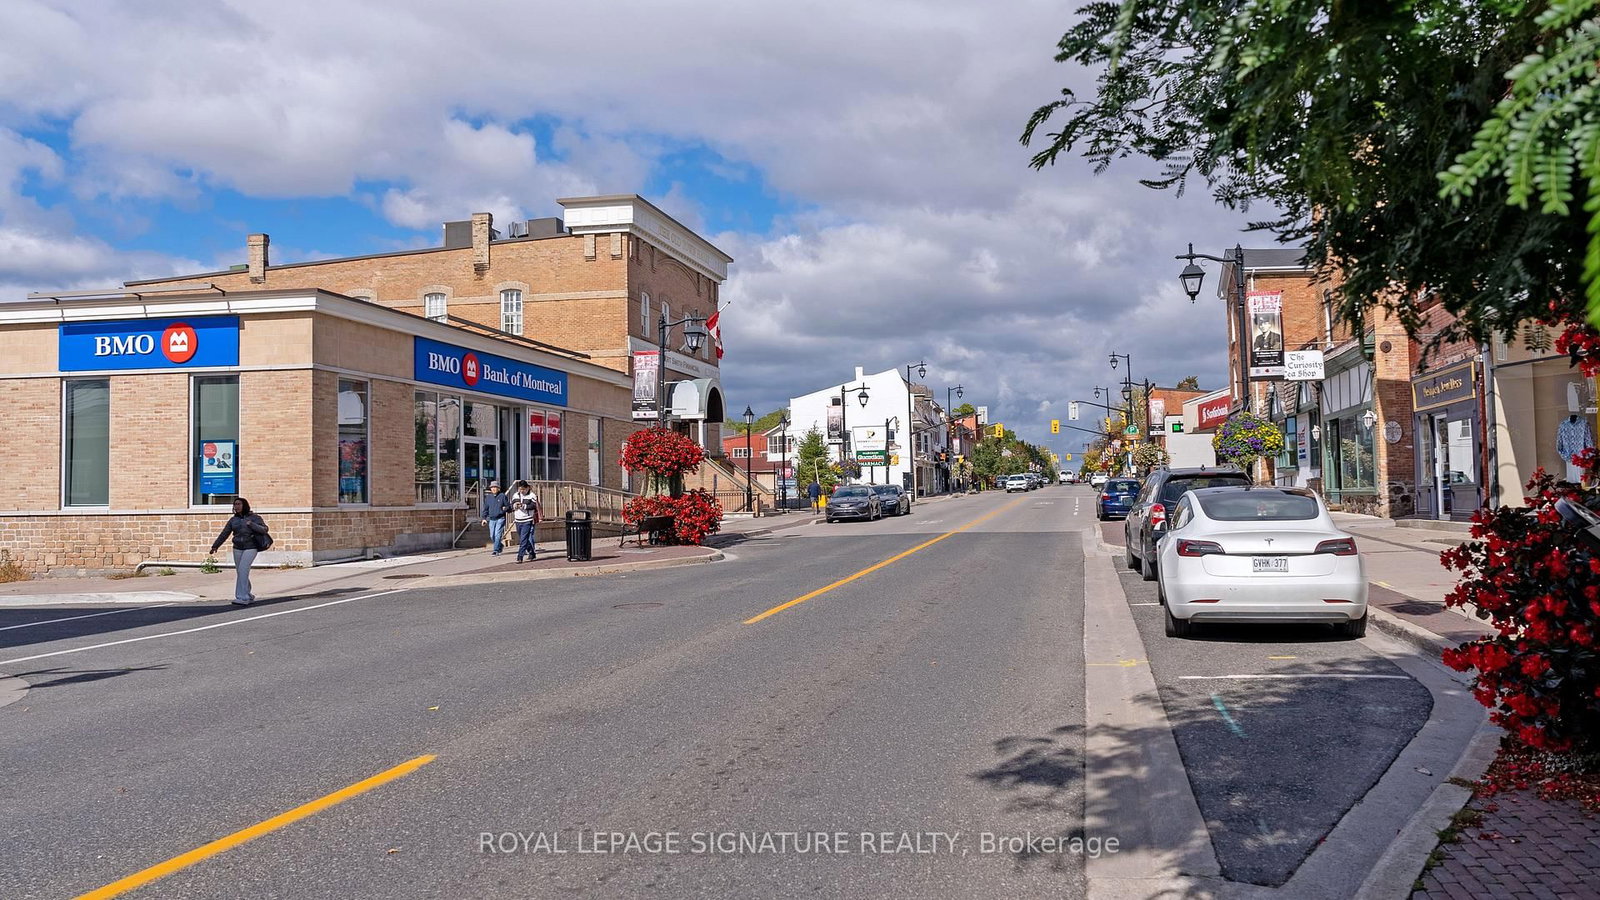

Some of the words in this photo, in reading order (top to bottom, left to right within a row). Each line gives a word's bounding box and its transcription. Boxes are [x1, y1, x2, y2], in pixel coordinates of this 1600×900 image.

[94, 334, 155, 356] BMO
[1289, 353, 1305, 361] The
[1287, 361, 1323, 370] Curiosity
[428, 352, 460, 374] BMO
[483, 364, 509, 386] Bank
[511, 370, 521, 386] of
[522, 373, 562, 395] Montreal
[1298, 369, 1317, 378] Shop
[1253, 558, 1271, 568] GVHK
[1274, 558, 1287, 568] 377
